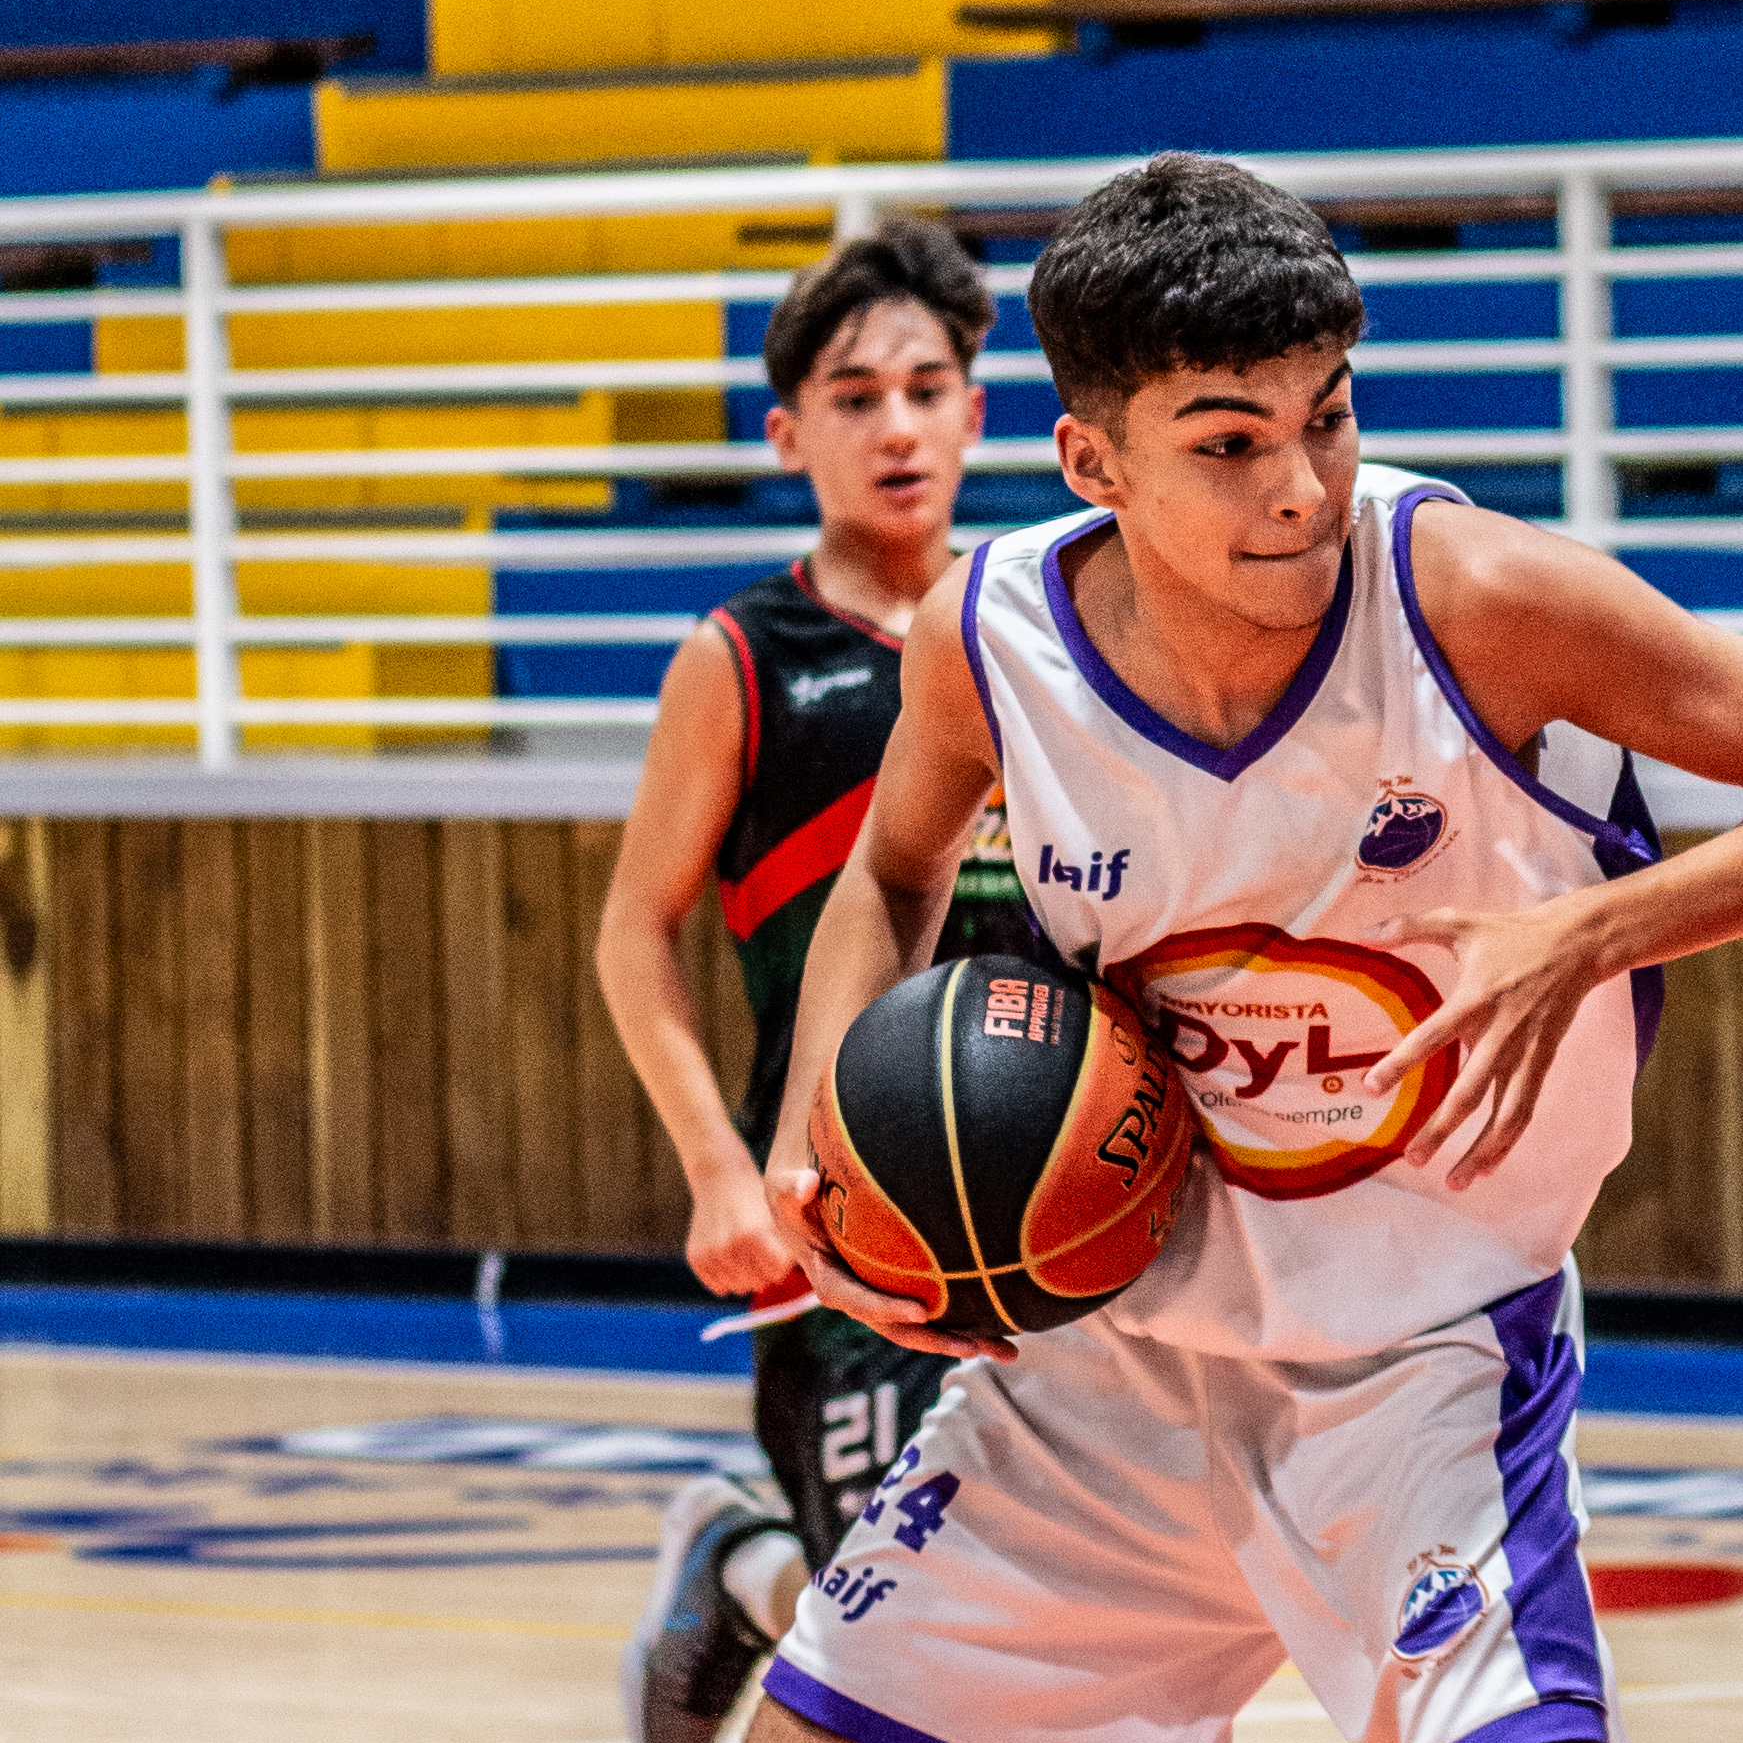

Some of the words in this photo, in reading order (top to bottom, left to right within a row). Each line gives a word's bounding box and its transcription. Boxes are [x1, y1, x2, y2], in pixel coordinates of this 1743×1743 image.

[983, 978, 1029, 1039] FIBA
[1027, 983, 1050, 1043] APPROVED
[1158, 1007, 1391, 1099] DyL
[822, 1382, 898, 1483] 21
